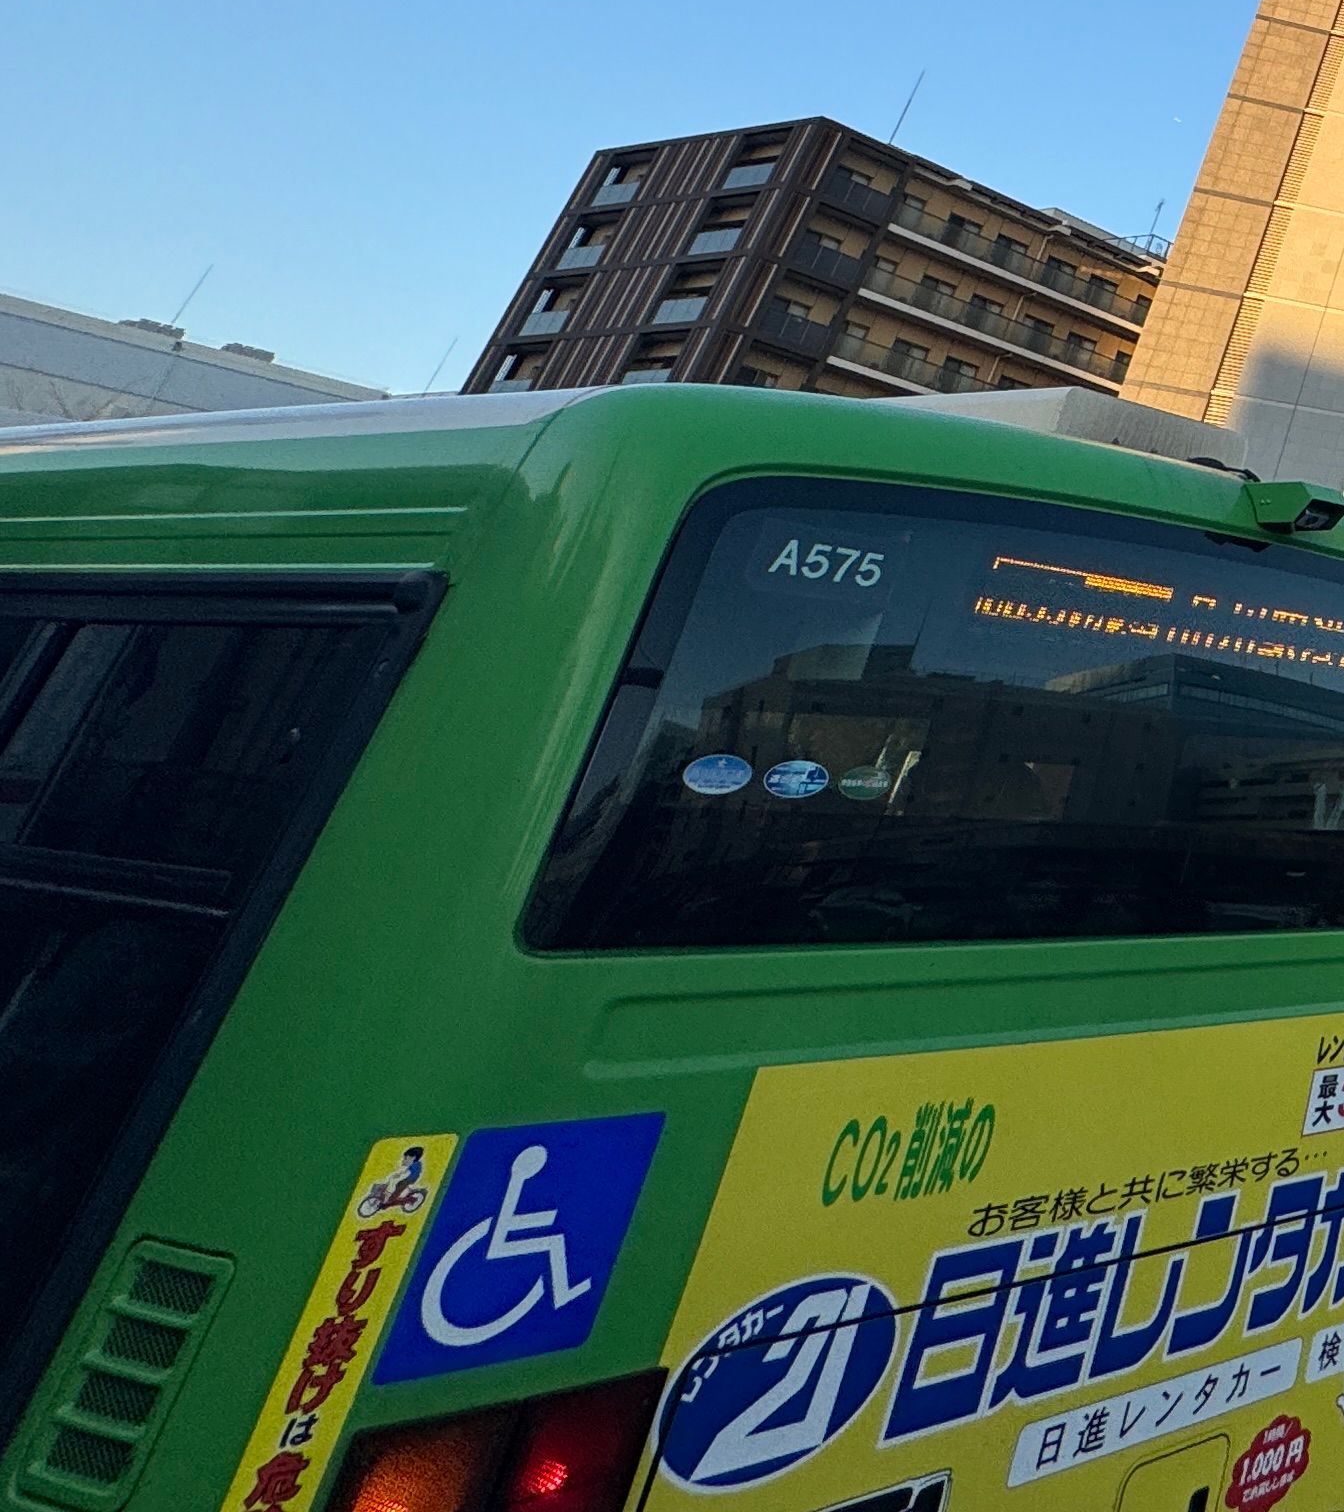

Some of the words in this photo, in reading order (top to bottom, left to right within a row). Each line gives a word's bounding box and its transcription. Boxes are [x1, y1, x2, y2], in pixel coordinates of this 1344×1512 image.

[768, 539, 884, 587] A575
[244, 1220, 407, 1512] すり抜けは危
[1035, 1361, 1282, 1472] 日進レンタカー
